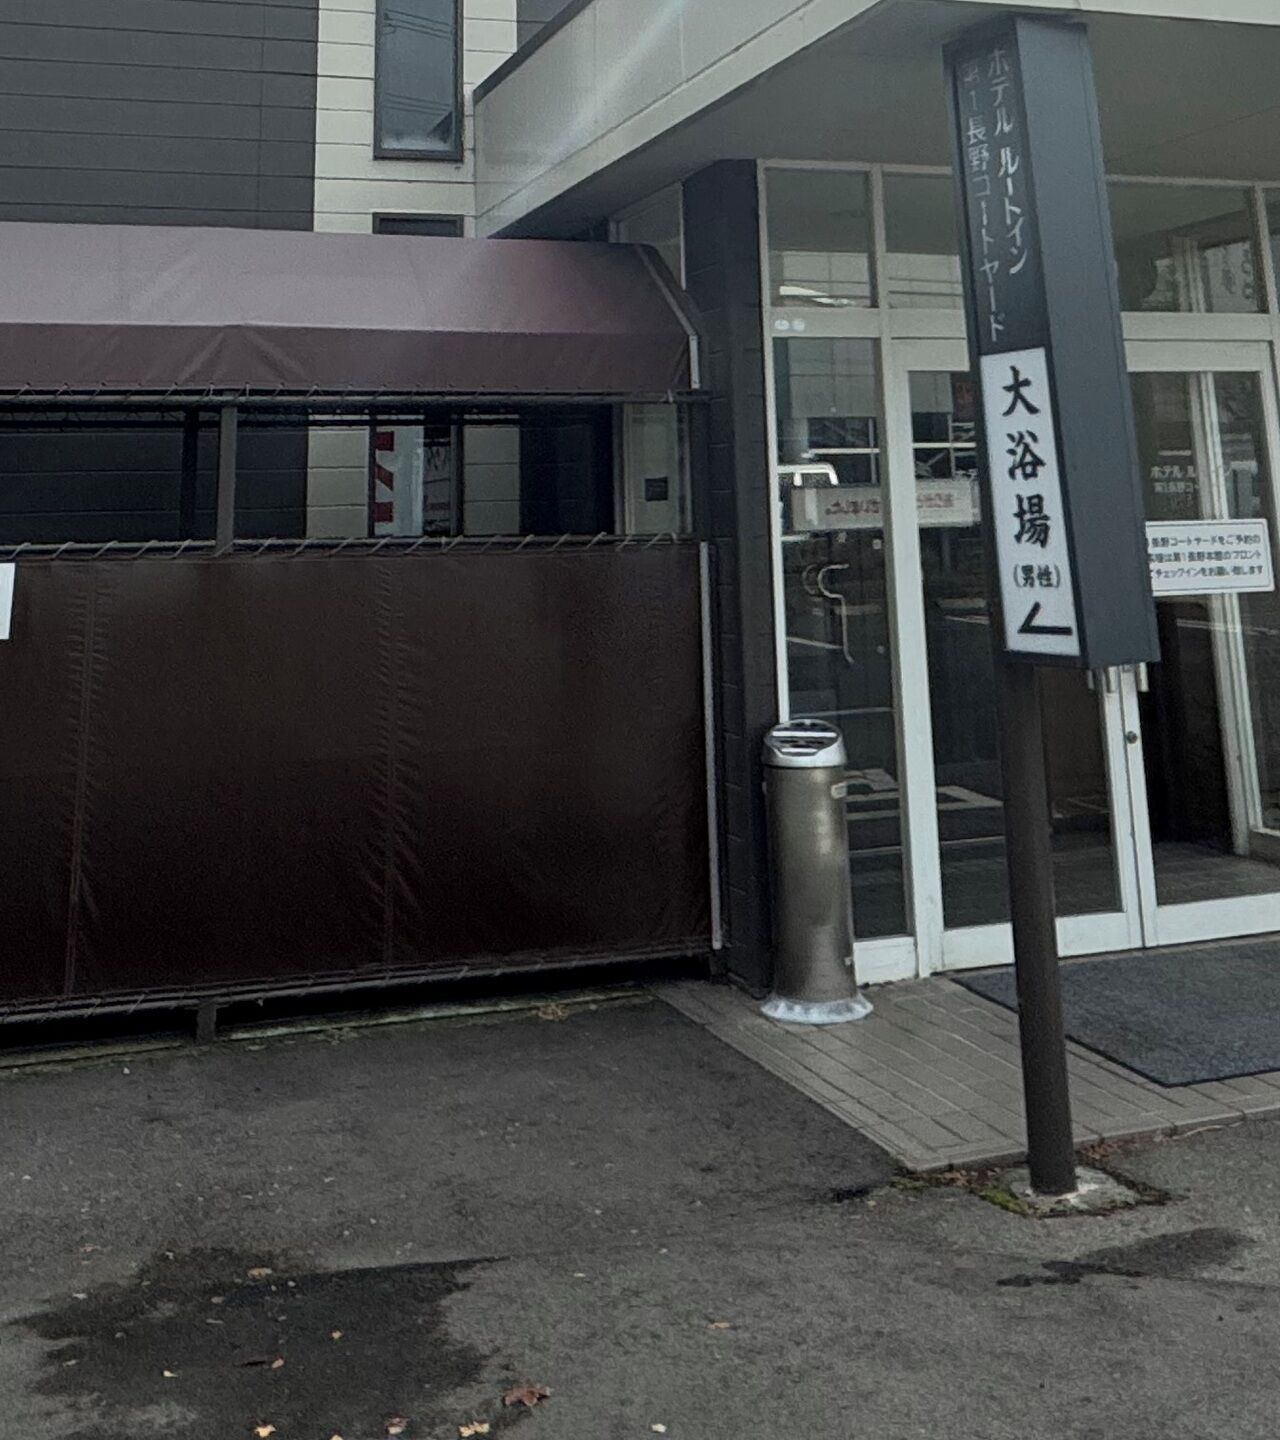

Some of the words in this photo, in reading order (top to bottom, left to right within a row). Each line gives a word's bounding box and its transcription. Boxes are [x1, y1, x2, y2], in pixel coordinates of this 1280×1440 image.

[987, 50, 1012, 136] ホテル
[998, 147, 1027, 274] ルートイン
[1002, 365, 1051, 548] 大浴場
[1013, 564, 1061, 589] (男性)
